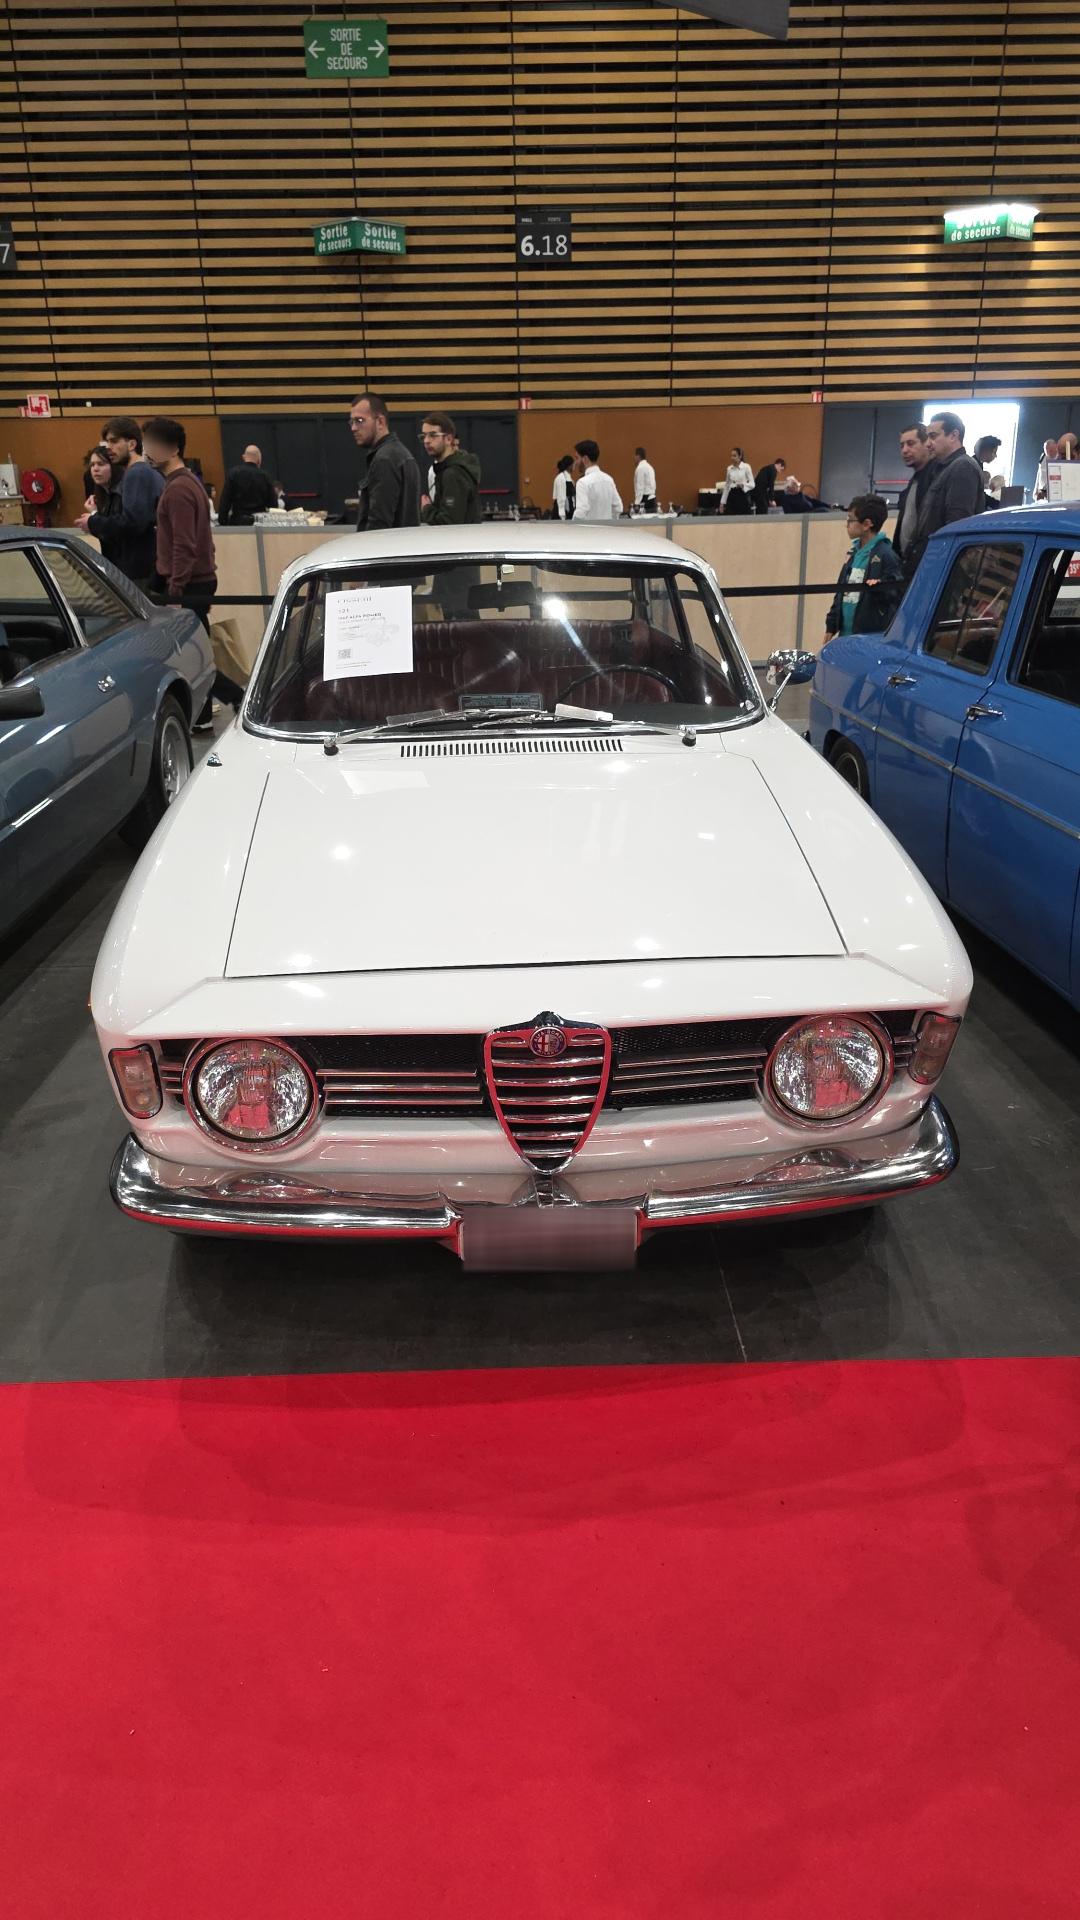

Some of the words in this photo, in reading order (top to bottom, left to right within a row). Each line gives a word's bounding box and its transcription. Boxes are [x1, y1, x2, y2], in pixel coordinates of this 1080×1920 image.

[330, 28, 362, 41] SORTIE
[340, 42, 353, 56] DE
[326, 56, 368, 70] SECOURS
[320, 224, 349, 240] Sortie
[364, 222, 397, 240] Sortie
[951, 229, 962, 242] de
[964, 225, 1001, 239] secours
[318, 241, 327, 253] de
[327, 237, 352, 251] secours
[361, 236, 371, 248] de
[372, 239, 401, 252] secours
[520, 234, 568, 256] 6.18
